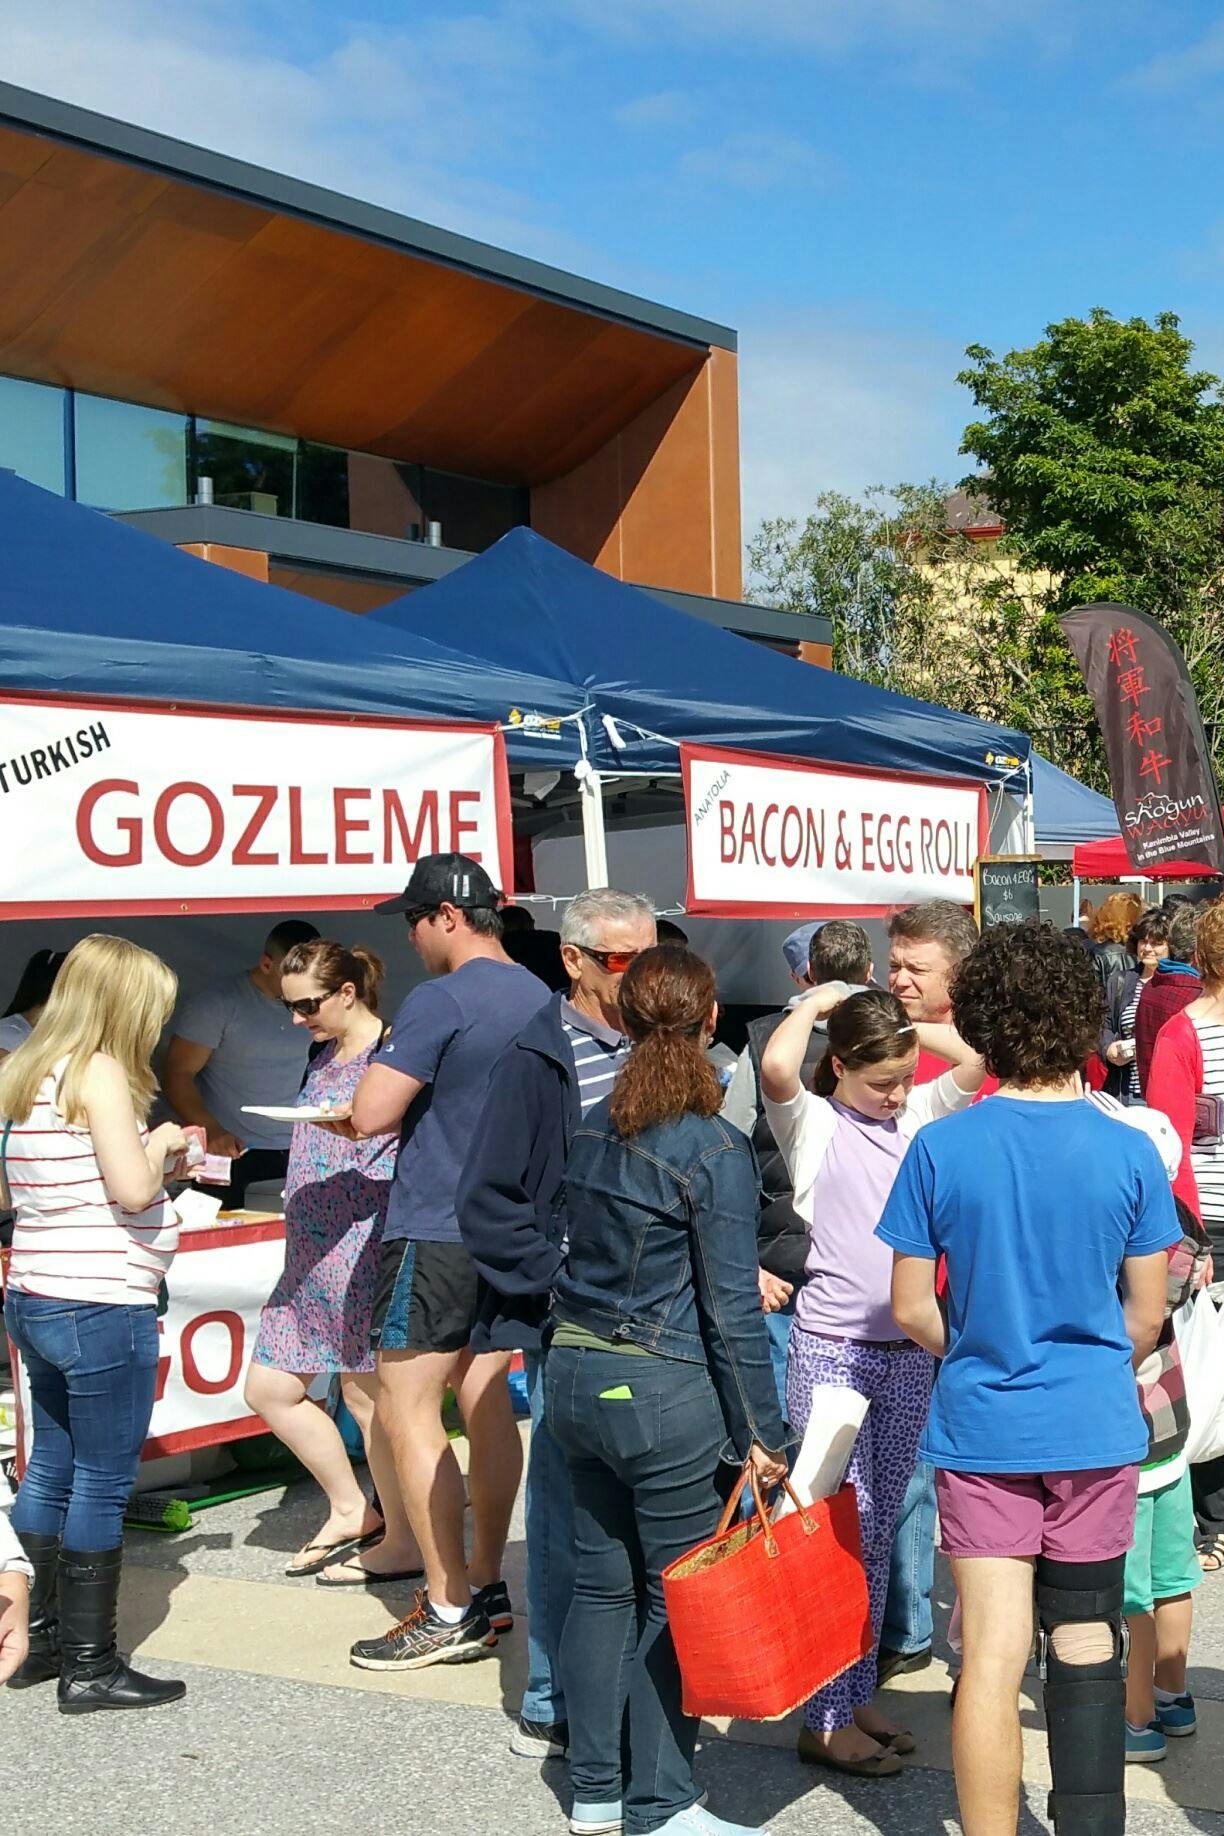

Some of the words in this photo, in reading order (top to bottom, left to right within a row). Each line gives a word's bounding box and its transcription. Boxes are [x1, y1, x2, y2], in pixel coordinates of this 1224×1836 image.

[0, 721, 111, 793] TURKISH
[75, 778, 482, 867] GOZLEME
[693, 769, 732, 828] ANATOLIA
[719, 799, 826, 868] BACON
[834, 809, 852, 870] &
[861, 812, 914, 874] EGG
[919, 817, 974, 877] ROLL
[1145, 850, 1158, 859] the
[1158, 844, 1176, 854] Blue
[1176, 832, 1216, 849] Mountains
[1178, 827, 1201, 839] Valley
[1003, 889, 1014, 901] $6
